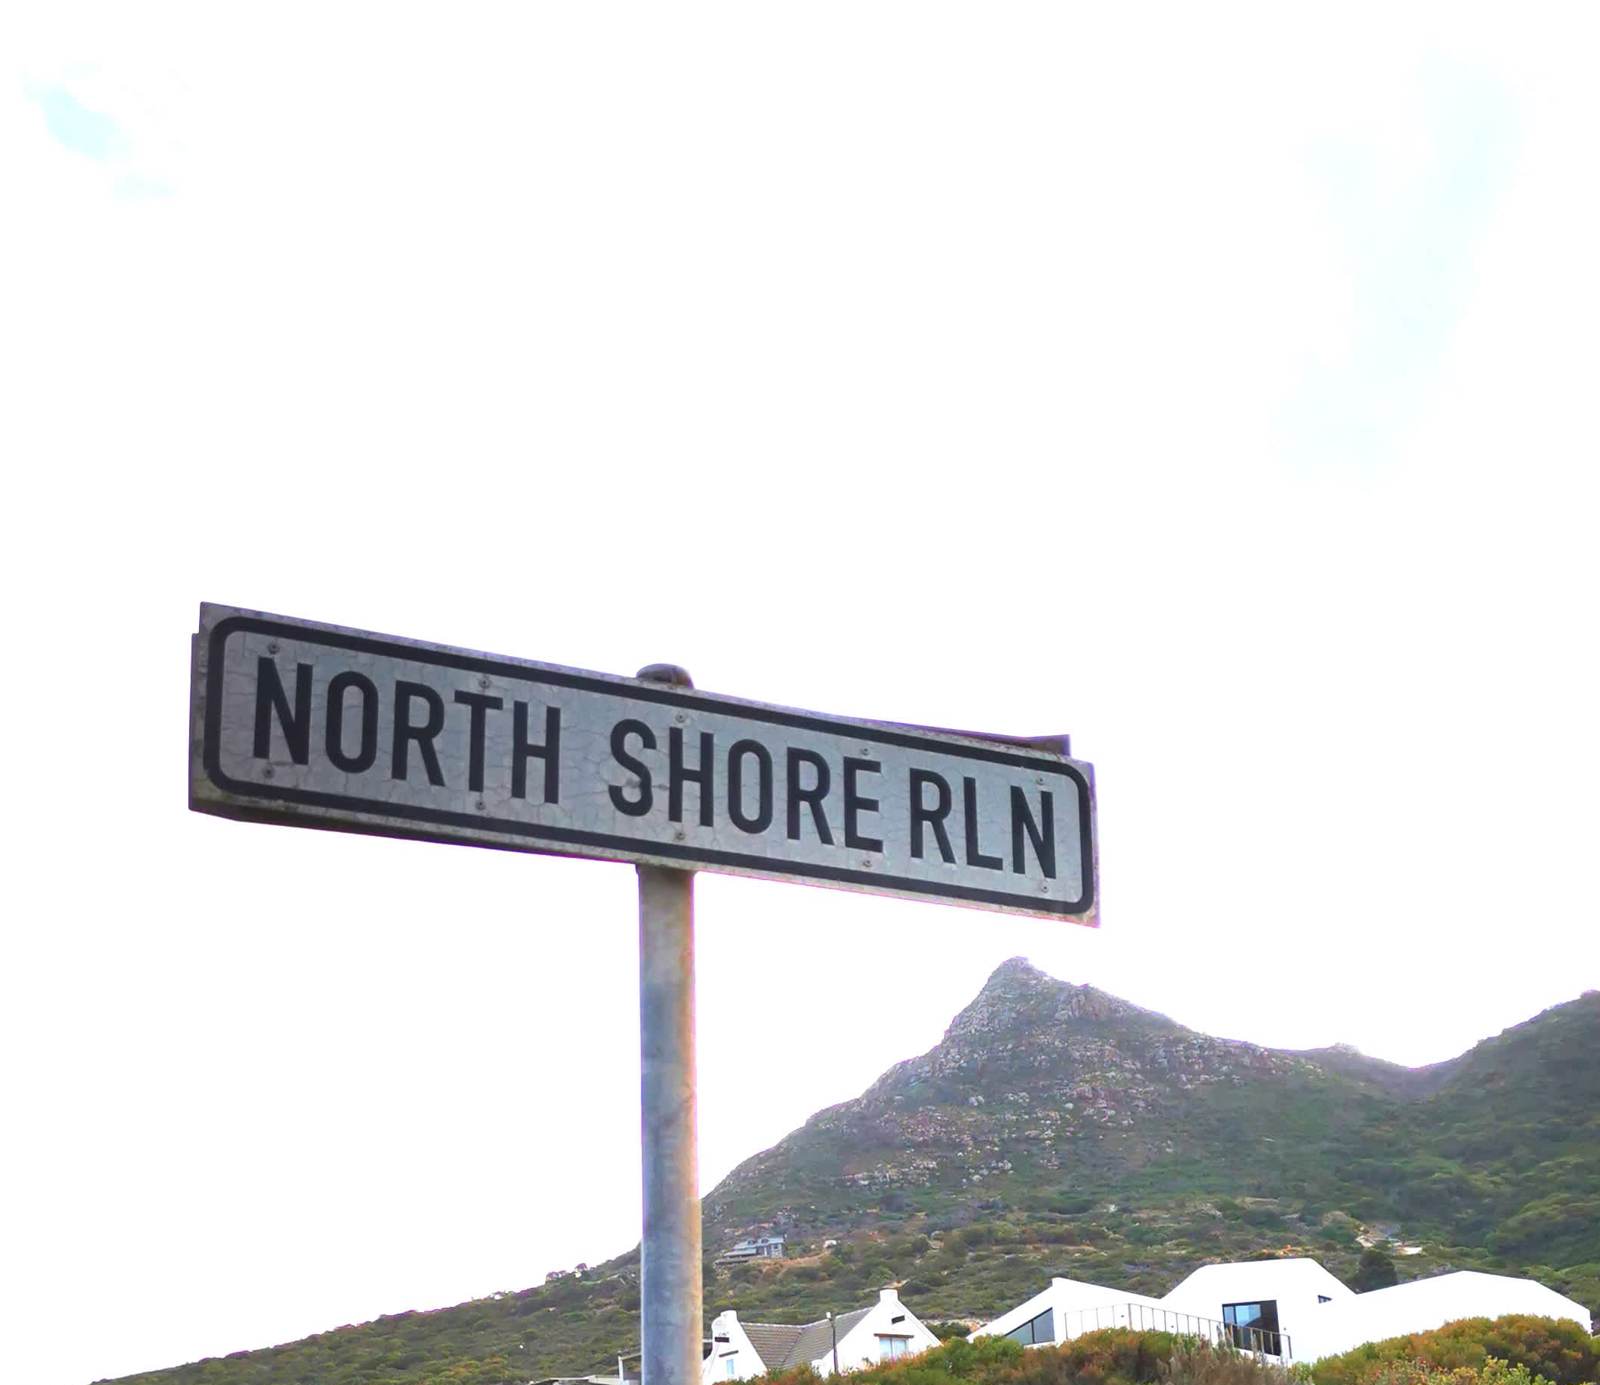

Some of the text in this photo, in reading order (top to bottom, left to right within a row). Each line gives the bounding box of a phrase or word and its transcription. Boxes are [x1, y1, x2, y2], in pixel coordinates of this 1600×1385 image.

[253, 656, 1057, 880] NORTH SHORE RLN
